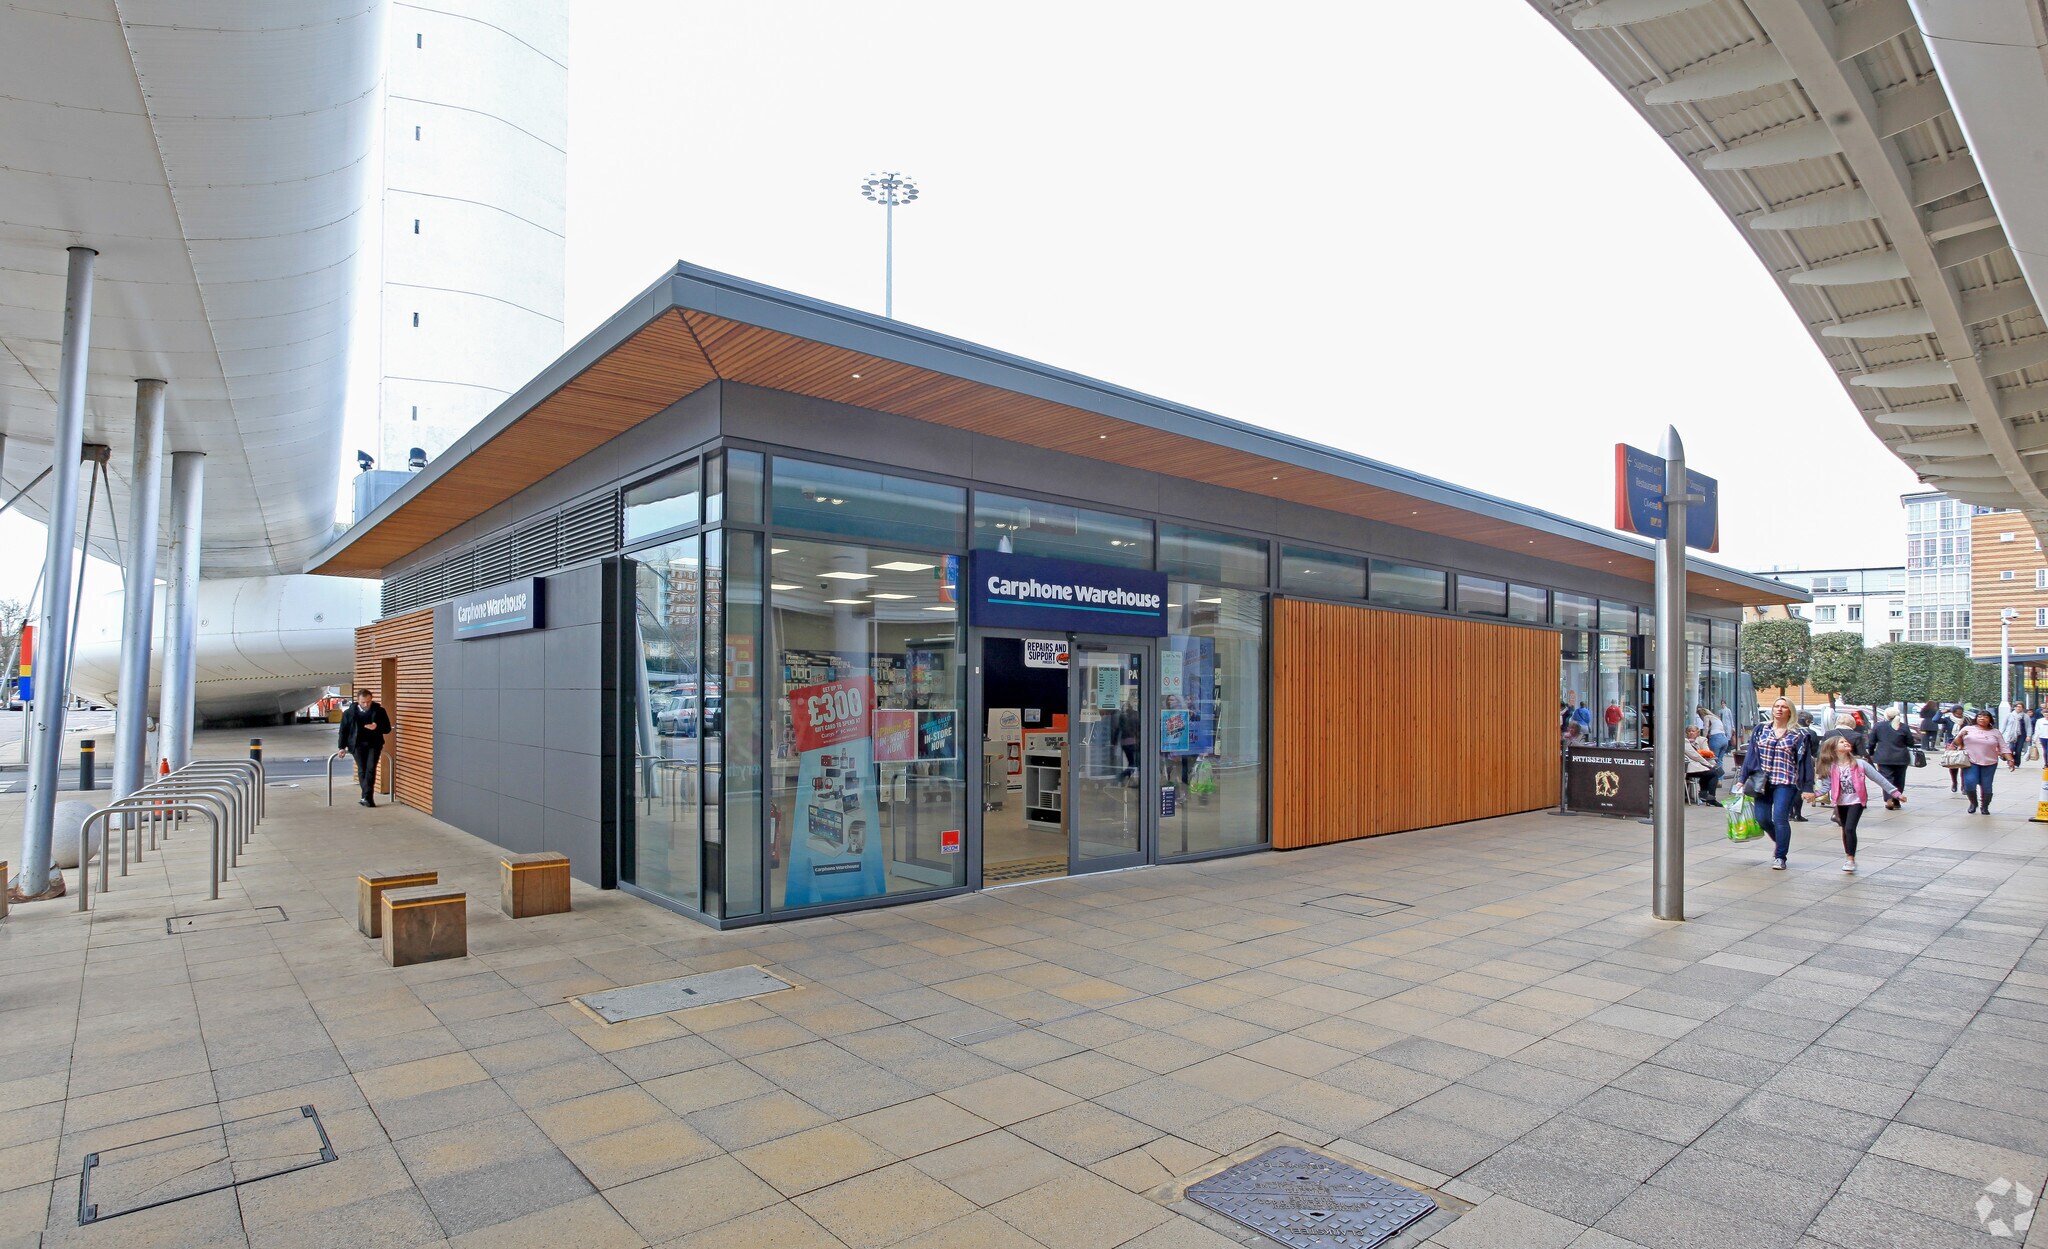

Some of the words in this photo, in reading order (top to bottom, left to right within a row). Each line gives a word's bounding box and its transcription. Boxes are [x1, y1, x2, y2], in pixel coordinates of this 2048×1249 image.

[1635, 477, 1658, 493] Restaurants
[987, 576, 1073, 600] Carphone
[1074, 584, 1161, 608] Warehouse
[458, 602, 487, 624] Carphone
[486, 592, 527, 616] Warehouse
[1027, 642, 1054, 652] REPAIRS
[1055, 643, 1067, 652] AND
[1028, 651, 1056, 661] SUPPORT
[807, 687, 863, 727] £300
[878, 729, 910, 746] IN-STORE
[924, 727, 953, 744] IN-STORE
[887, 742, 902, 754] NOW
[931, 739, 946, 752] NOW
[1572, 755, 1612, 764] PATISSERIE
[1613, 758, 1646, 766] VALERIE
